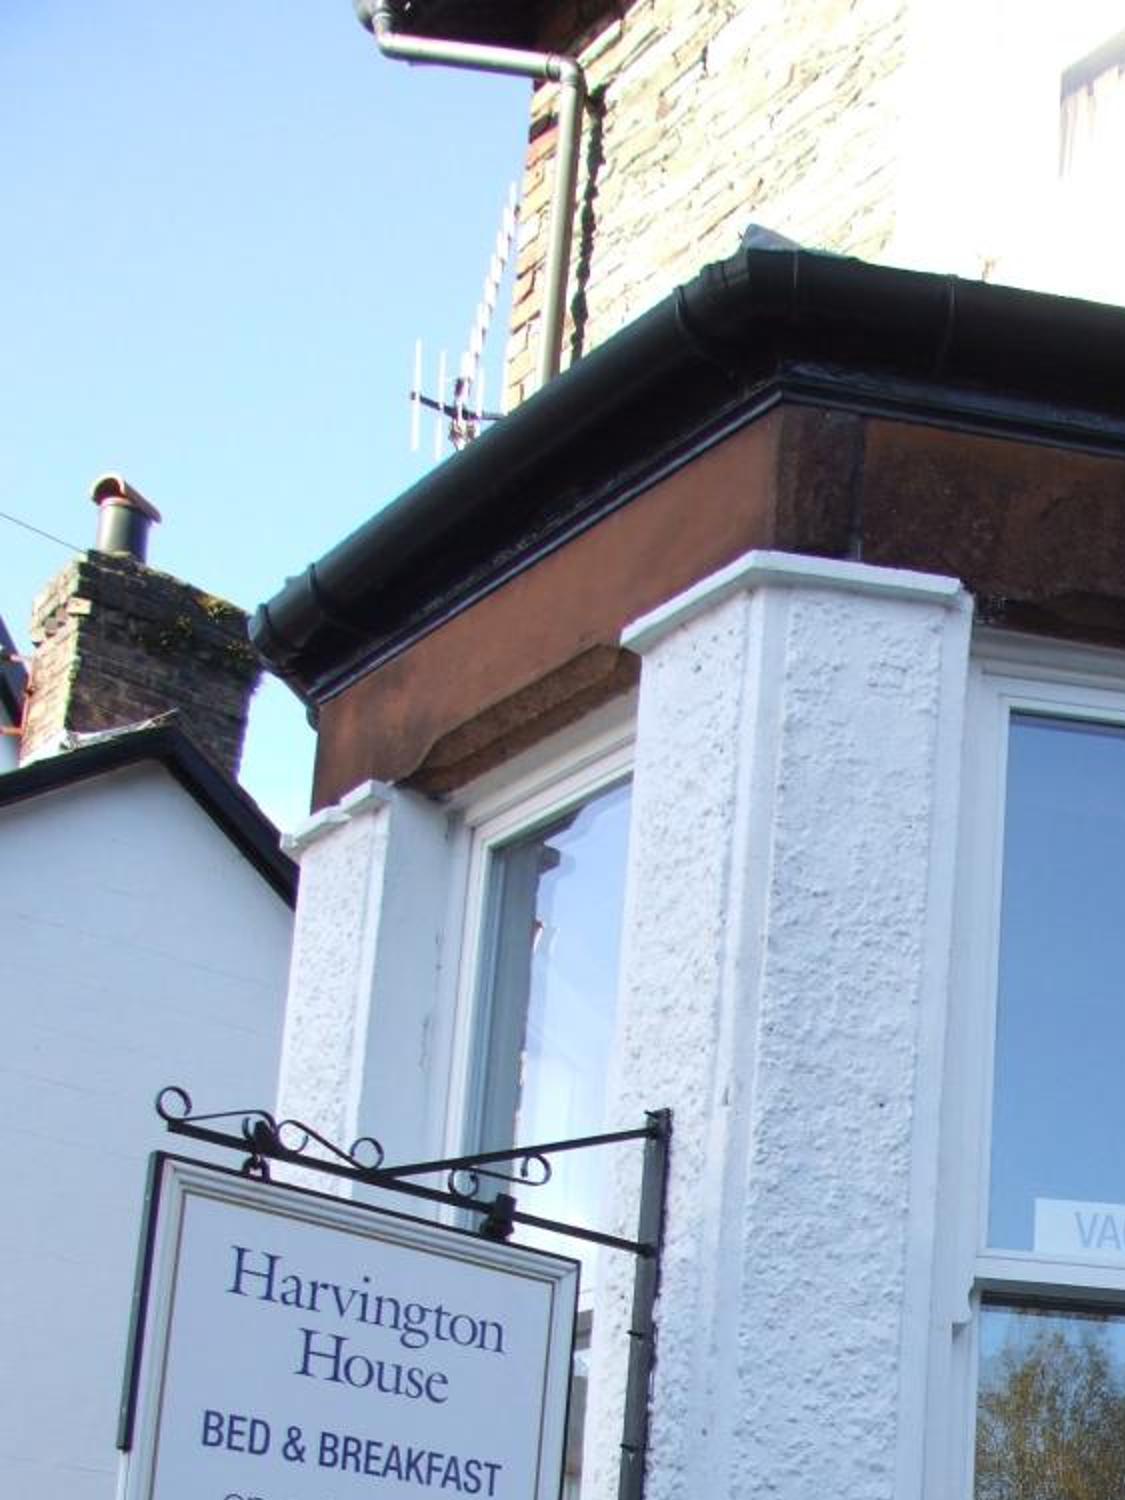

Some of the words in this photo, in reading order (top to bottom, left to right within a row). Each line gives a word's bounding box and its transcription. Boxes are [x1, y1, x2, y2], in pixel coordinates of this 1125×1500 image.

[226, 1246, 507, 1355] Harvington
[294, 1328, 449, 1404] House
[201, 1409, 271, 1457] BED
[281, 1426, 306, 1463] &
[317, 1433, 502, 1497] BREAKFAST
